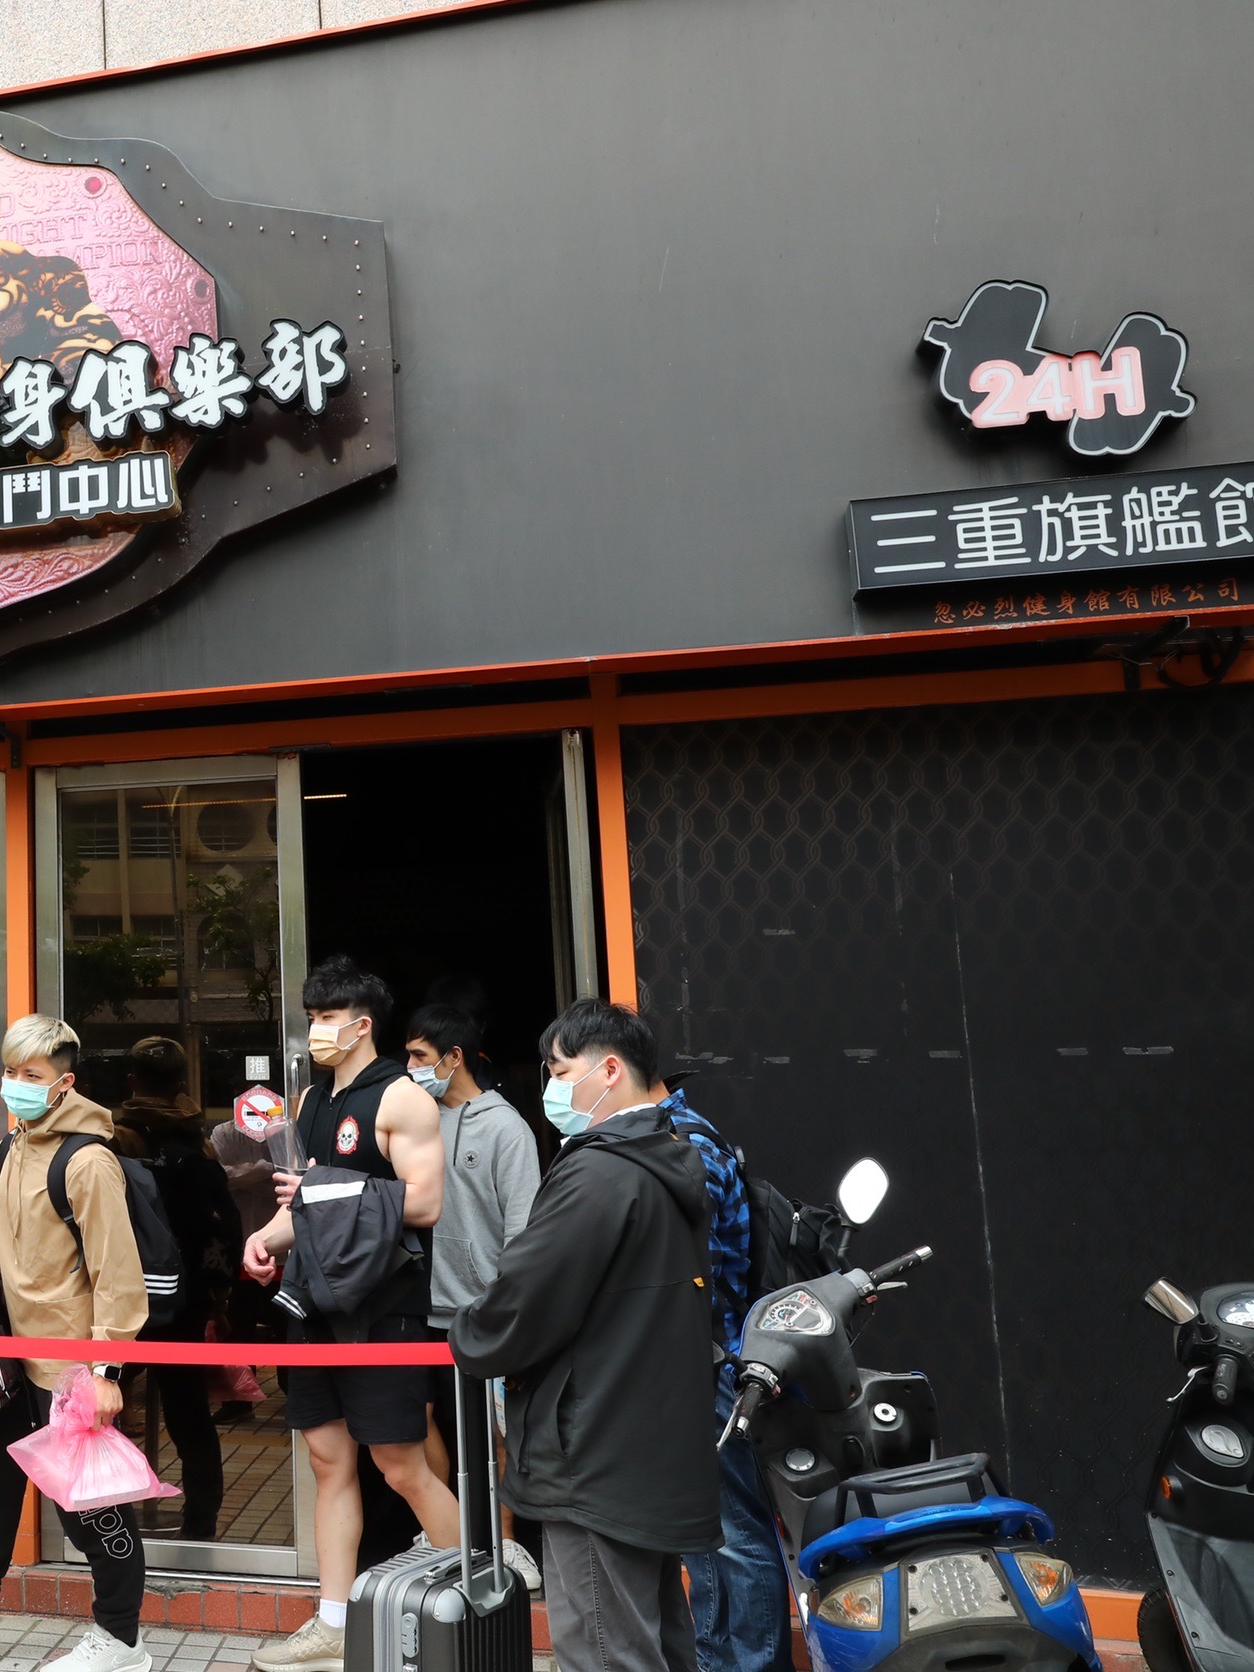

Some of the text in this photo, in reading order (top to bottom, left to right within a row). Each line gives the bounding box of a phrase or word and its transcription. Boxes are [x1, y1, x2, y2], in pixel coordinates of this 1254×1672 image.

[971, 347, 1145, 427] 24H
[934, 577, 1239, 624] 忽必烈健身館有限公司
